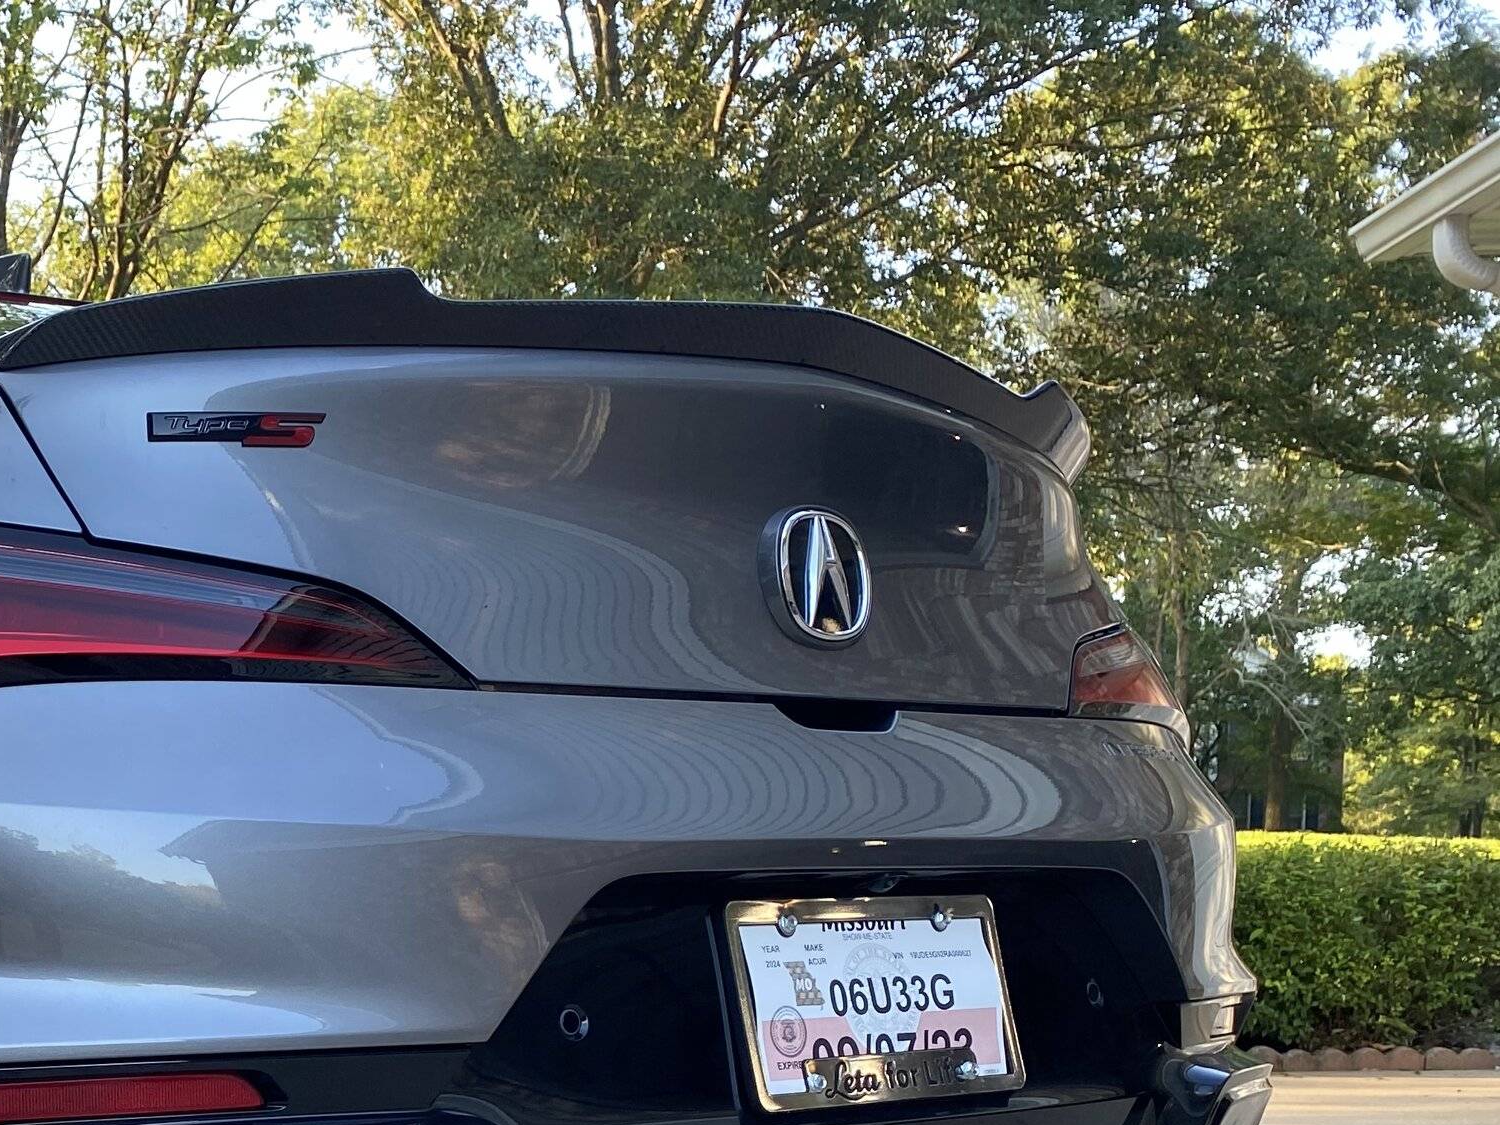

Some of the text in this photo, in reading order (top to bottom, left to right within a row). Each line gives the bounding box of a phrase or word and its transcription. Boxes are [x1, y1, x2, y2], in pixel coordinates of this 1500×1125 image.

[164, 413, 327, 448] Type S
[761, 945, 780, 953] YEAR
[795, 977, 813, 992] MO
[829, 973, 955, 1017] 06U33G
[825, 1060, 880, 1101] Leta
[885, 1060, 919, 1089] for
